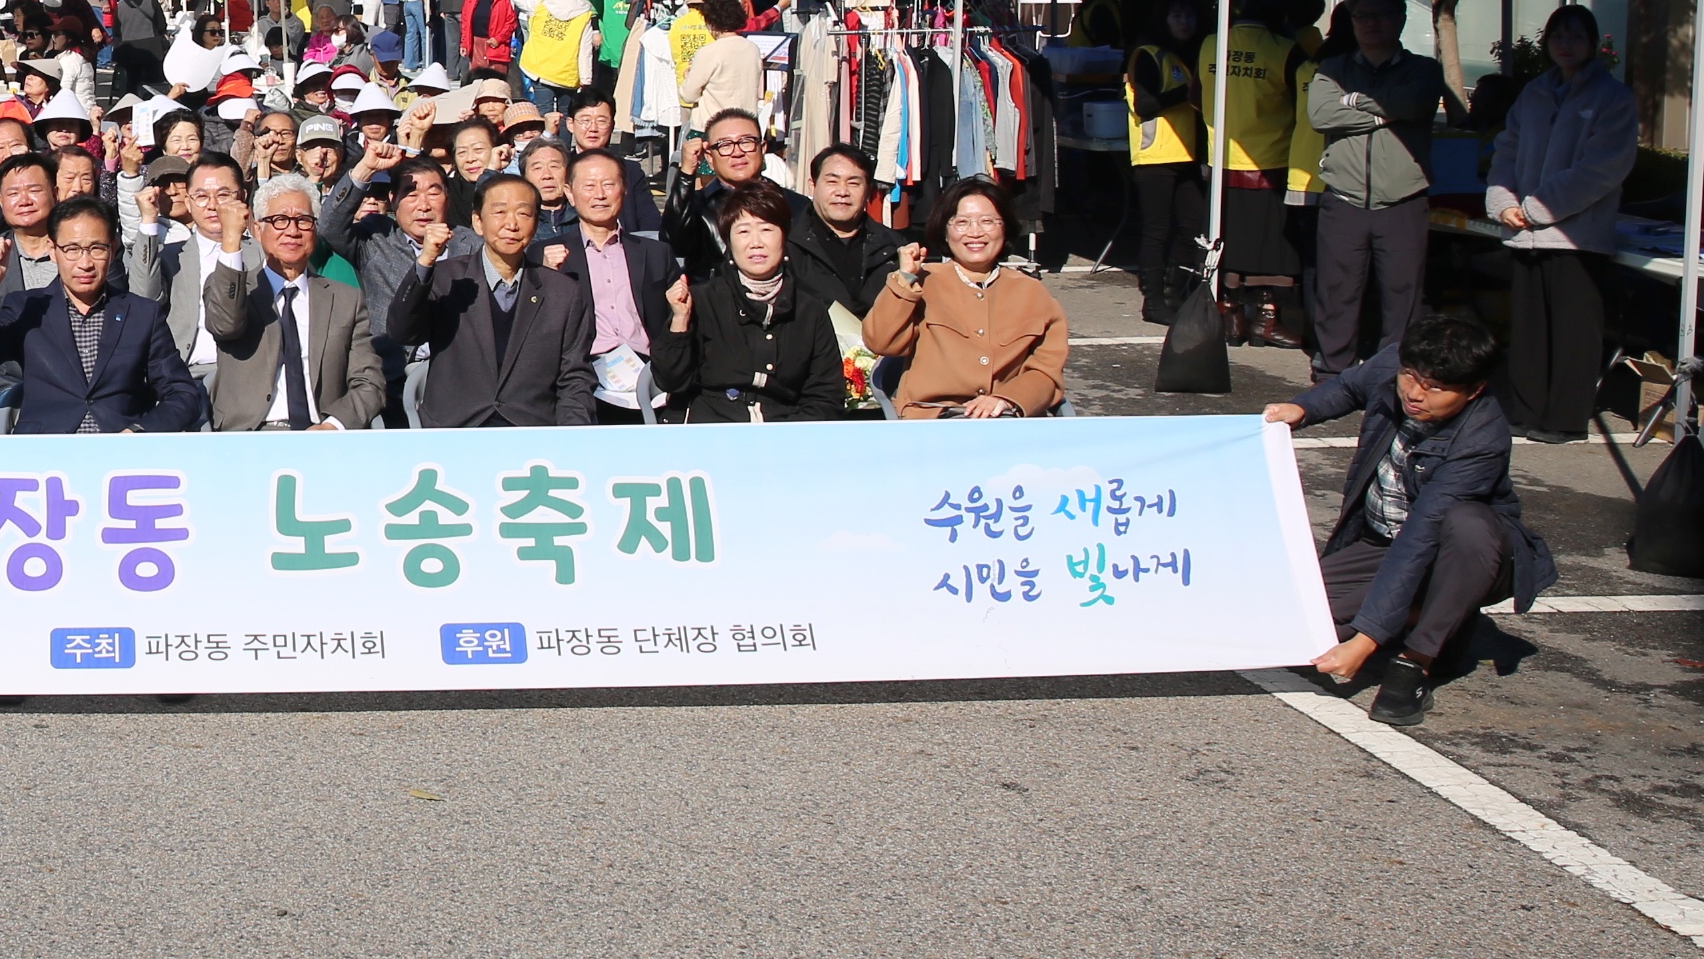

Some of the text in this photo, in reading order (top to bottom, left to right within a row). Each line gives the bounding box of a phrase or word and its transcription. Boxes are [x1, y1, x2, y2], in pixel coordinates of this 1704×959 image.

[305, 123, 334, 134] PING
[273, 466, 716, 588] 노송축제
[923, 478, 1177, 544] 수원을 새롭게
[933, 542, 1191, 608] 시민을 빛나게
[64, 630, 386, 663] 주최 파장동 주민자치회
[454, 623, 818, 659] 후원 파장동 단체장 협의회
